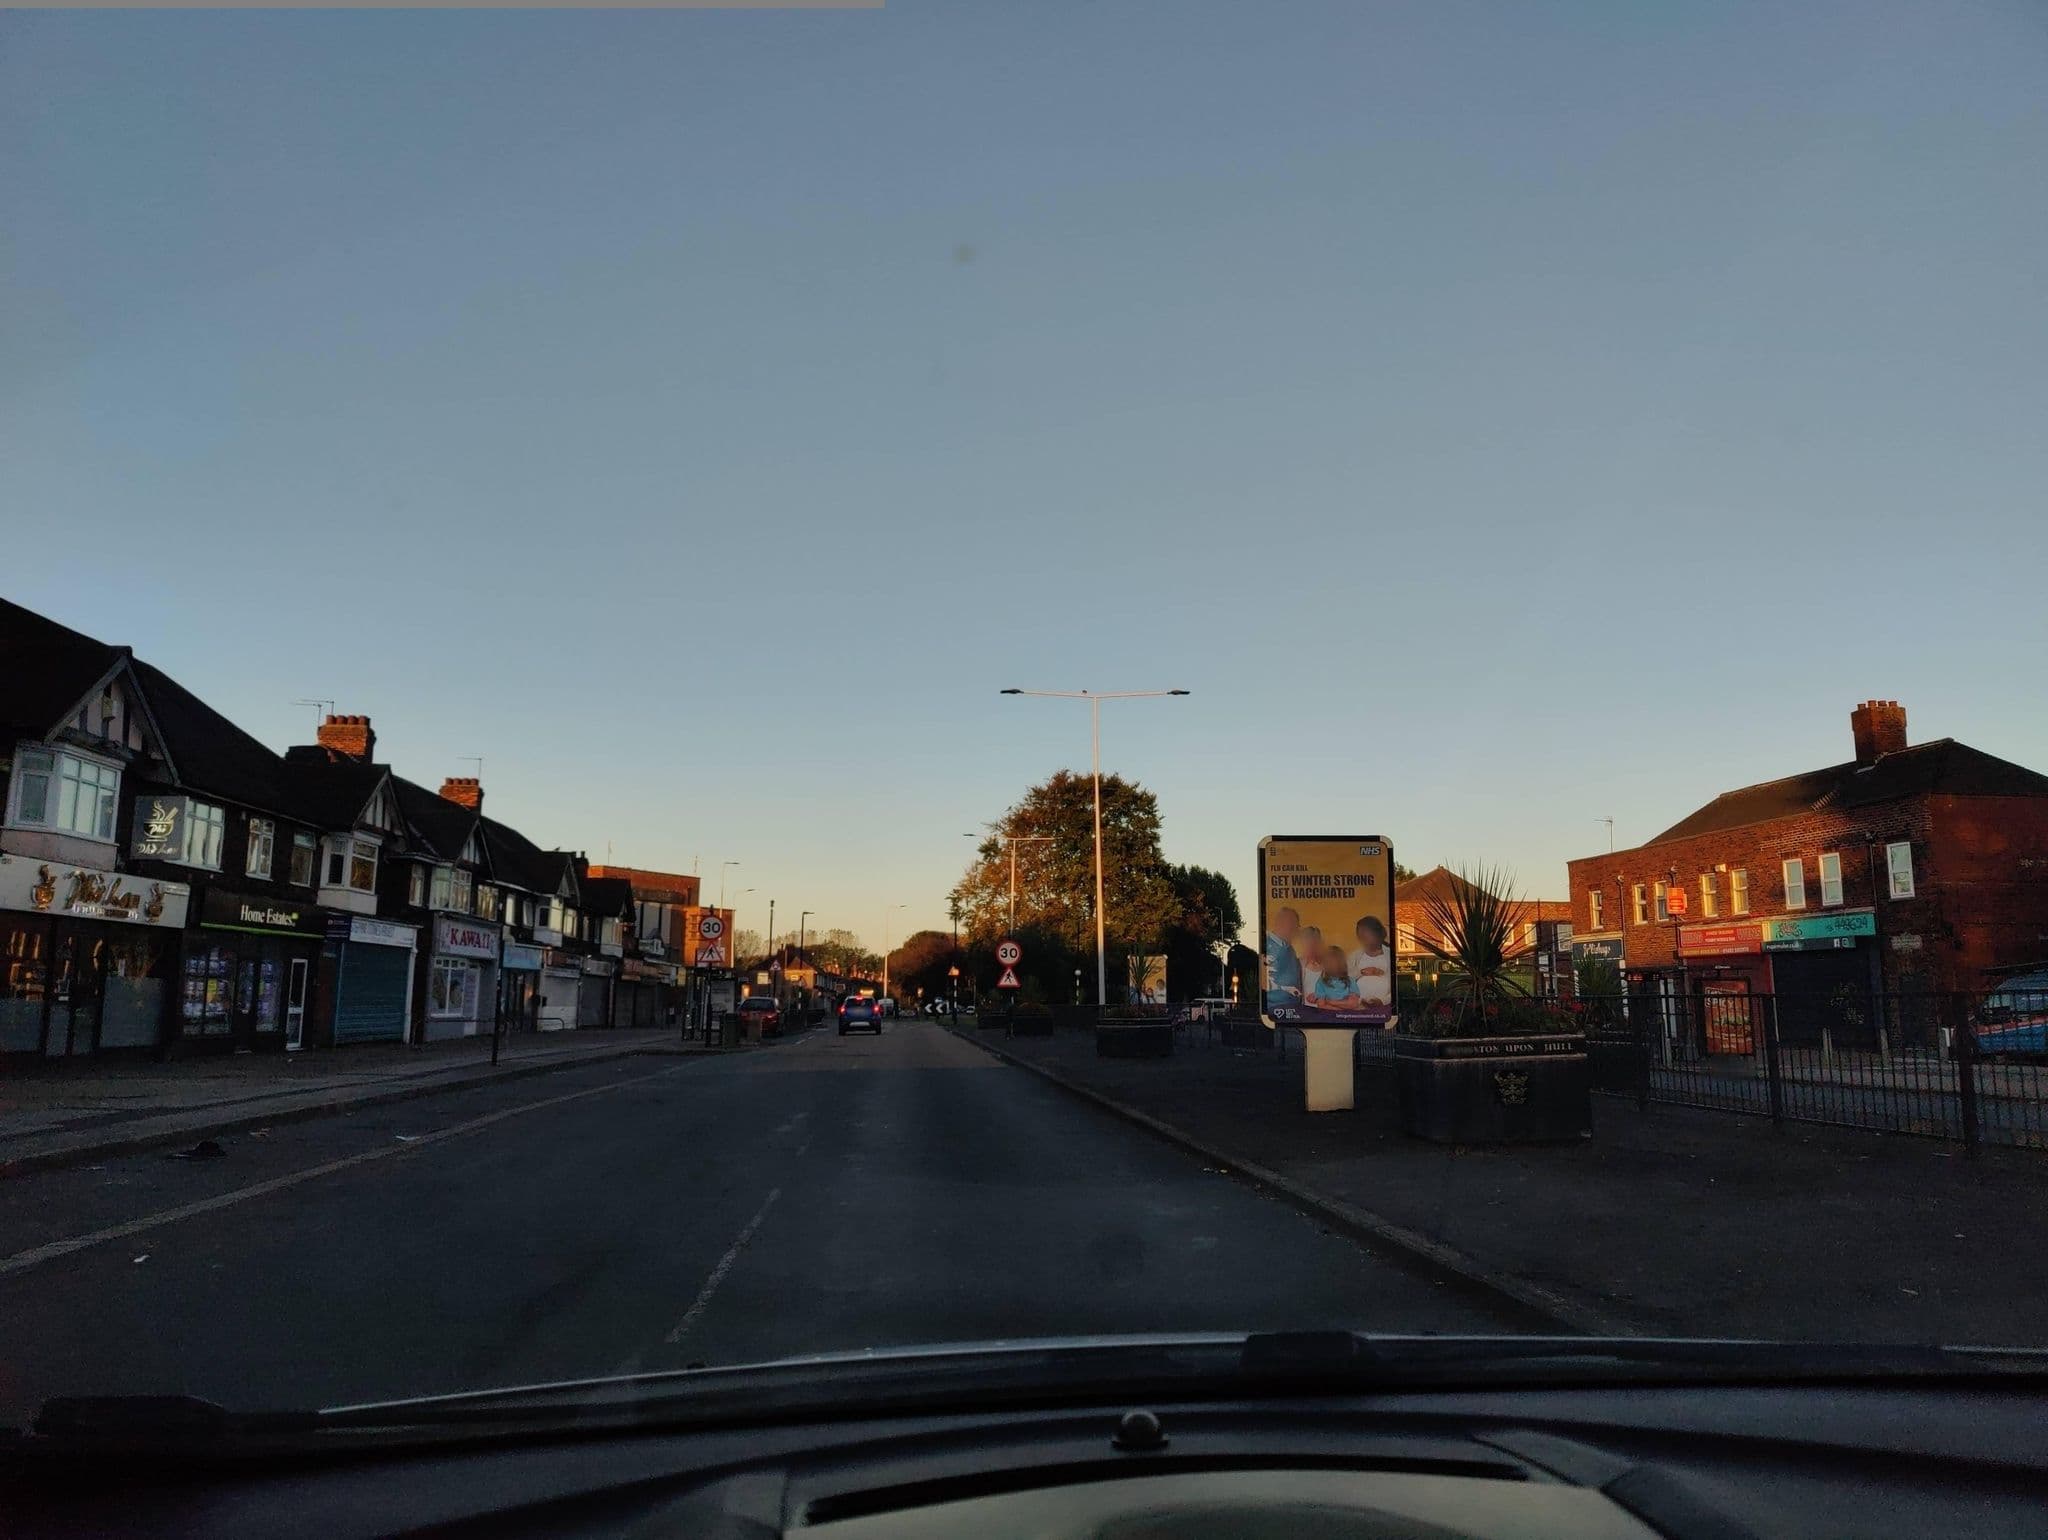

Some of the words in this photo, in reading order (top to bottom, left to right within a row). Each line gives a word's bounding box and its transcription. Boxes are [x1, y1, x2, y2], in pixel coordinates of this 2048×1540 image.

[1360, 847, 1380, 855] NHS
[1271, 875, 1289, 886] GET
[1292, 875, 1331, 886] WINTER
[1334, 874, 1375, 886] STRONG
[1271, 888, 1289, 898] GET
[1293, 887, 1355, 898] VACCINATED
[240, 904, 265, 923] Home
[266, 908, 292, 926] Estates
[703, 922, 720, 933] 30
[450, 928, 491, 949] KAWAII
[1000, 947, 1018, 958] 30
[1505, 1043, 1534, 1053] UPON
[1544, 1042, 1574, 1053] HULL
